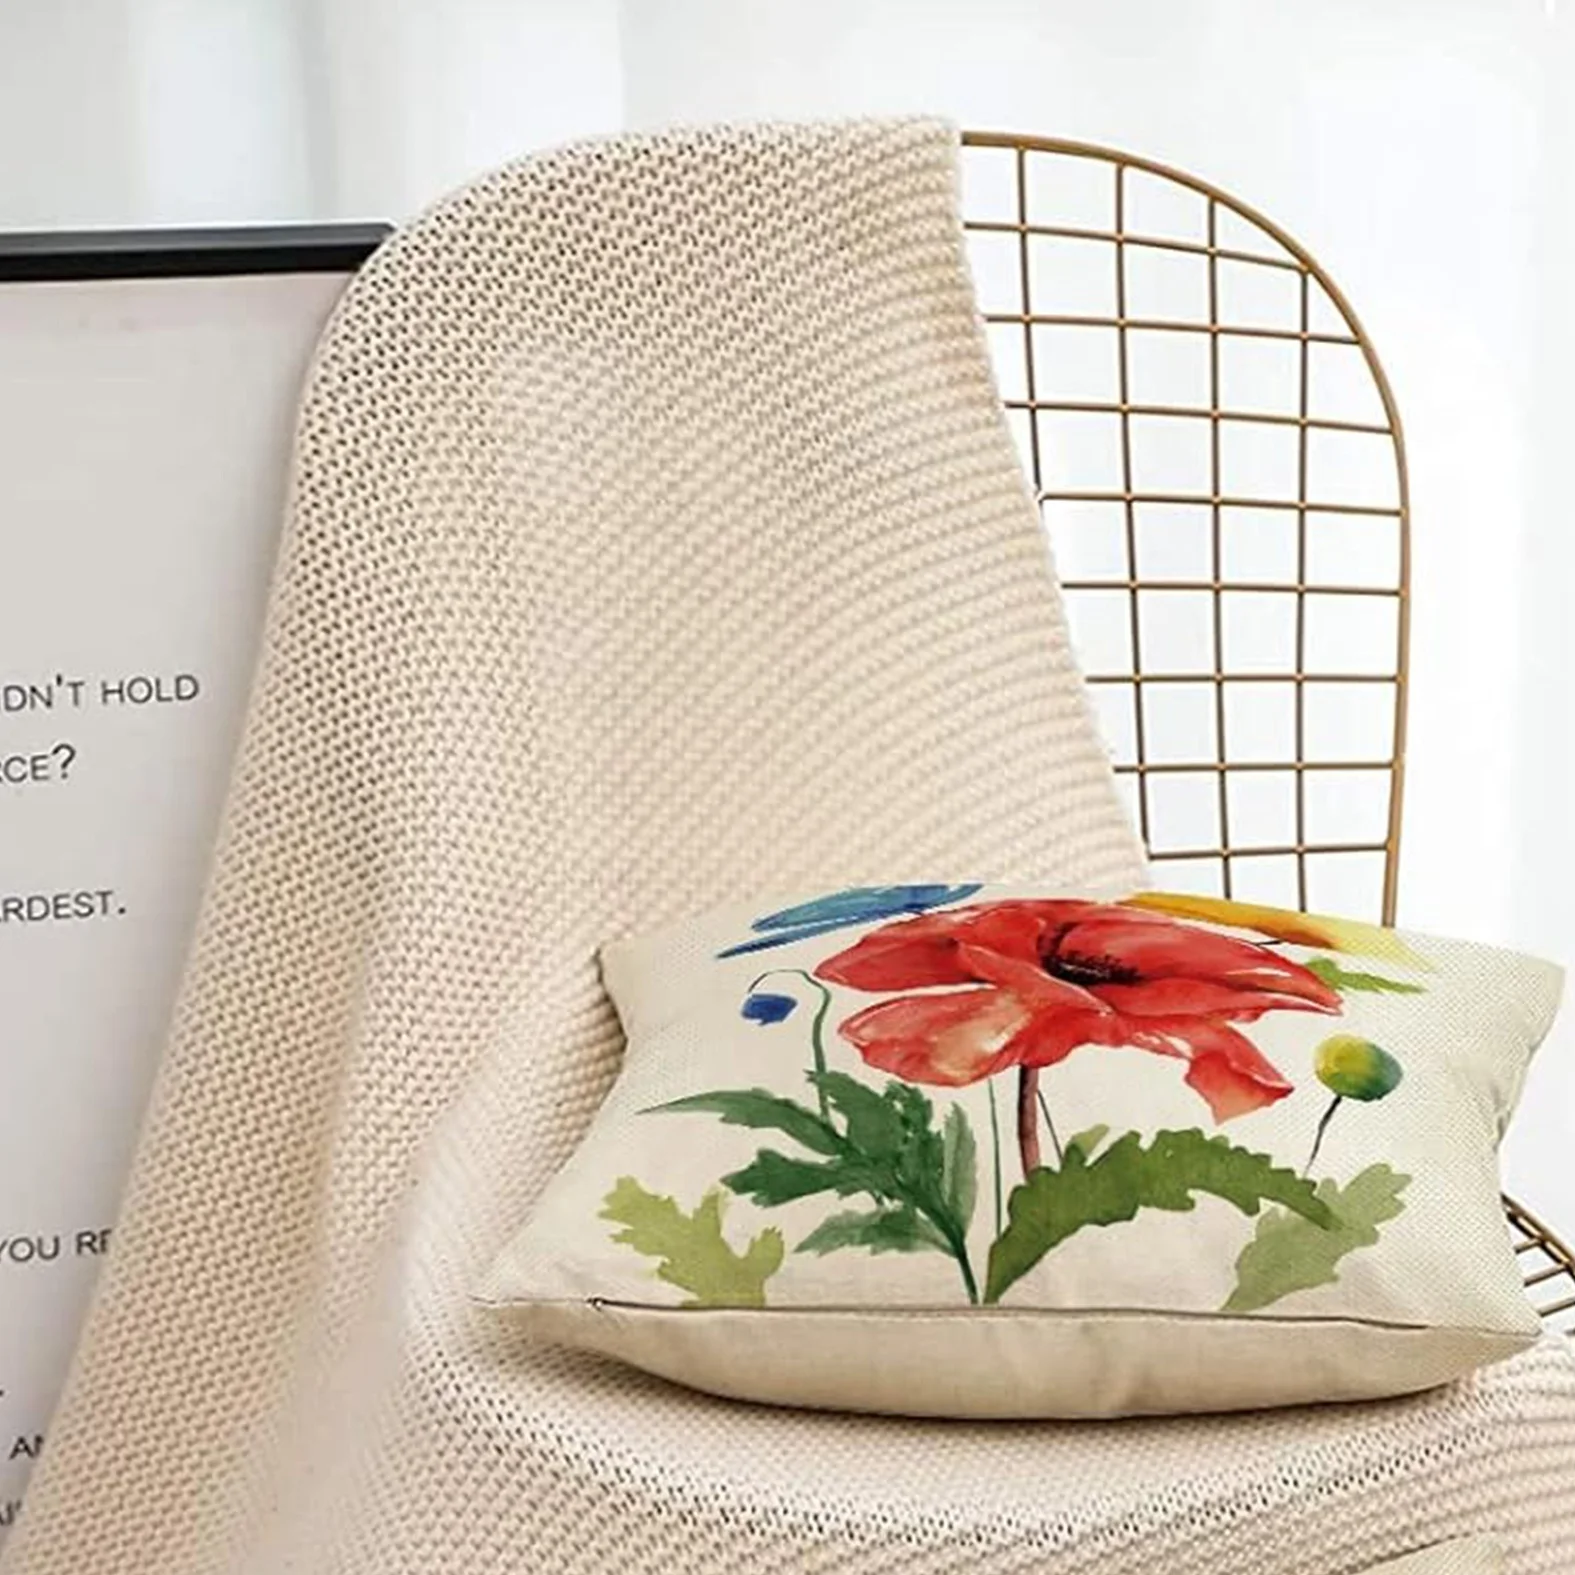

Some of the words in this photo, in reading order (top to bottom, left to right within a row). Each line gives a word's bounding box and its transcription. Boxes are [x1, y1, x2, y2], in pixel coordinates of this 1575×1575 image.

[101, 674, 200, 705] HOLD
[0, 743, 76, 783] CE?
[0, 890, 126, 923] RDEST.
